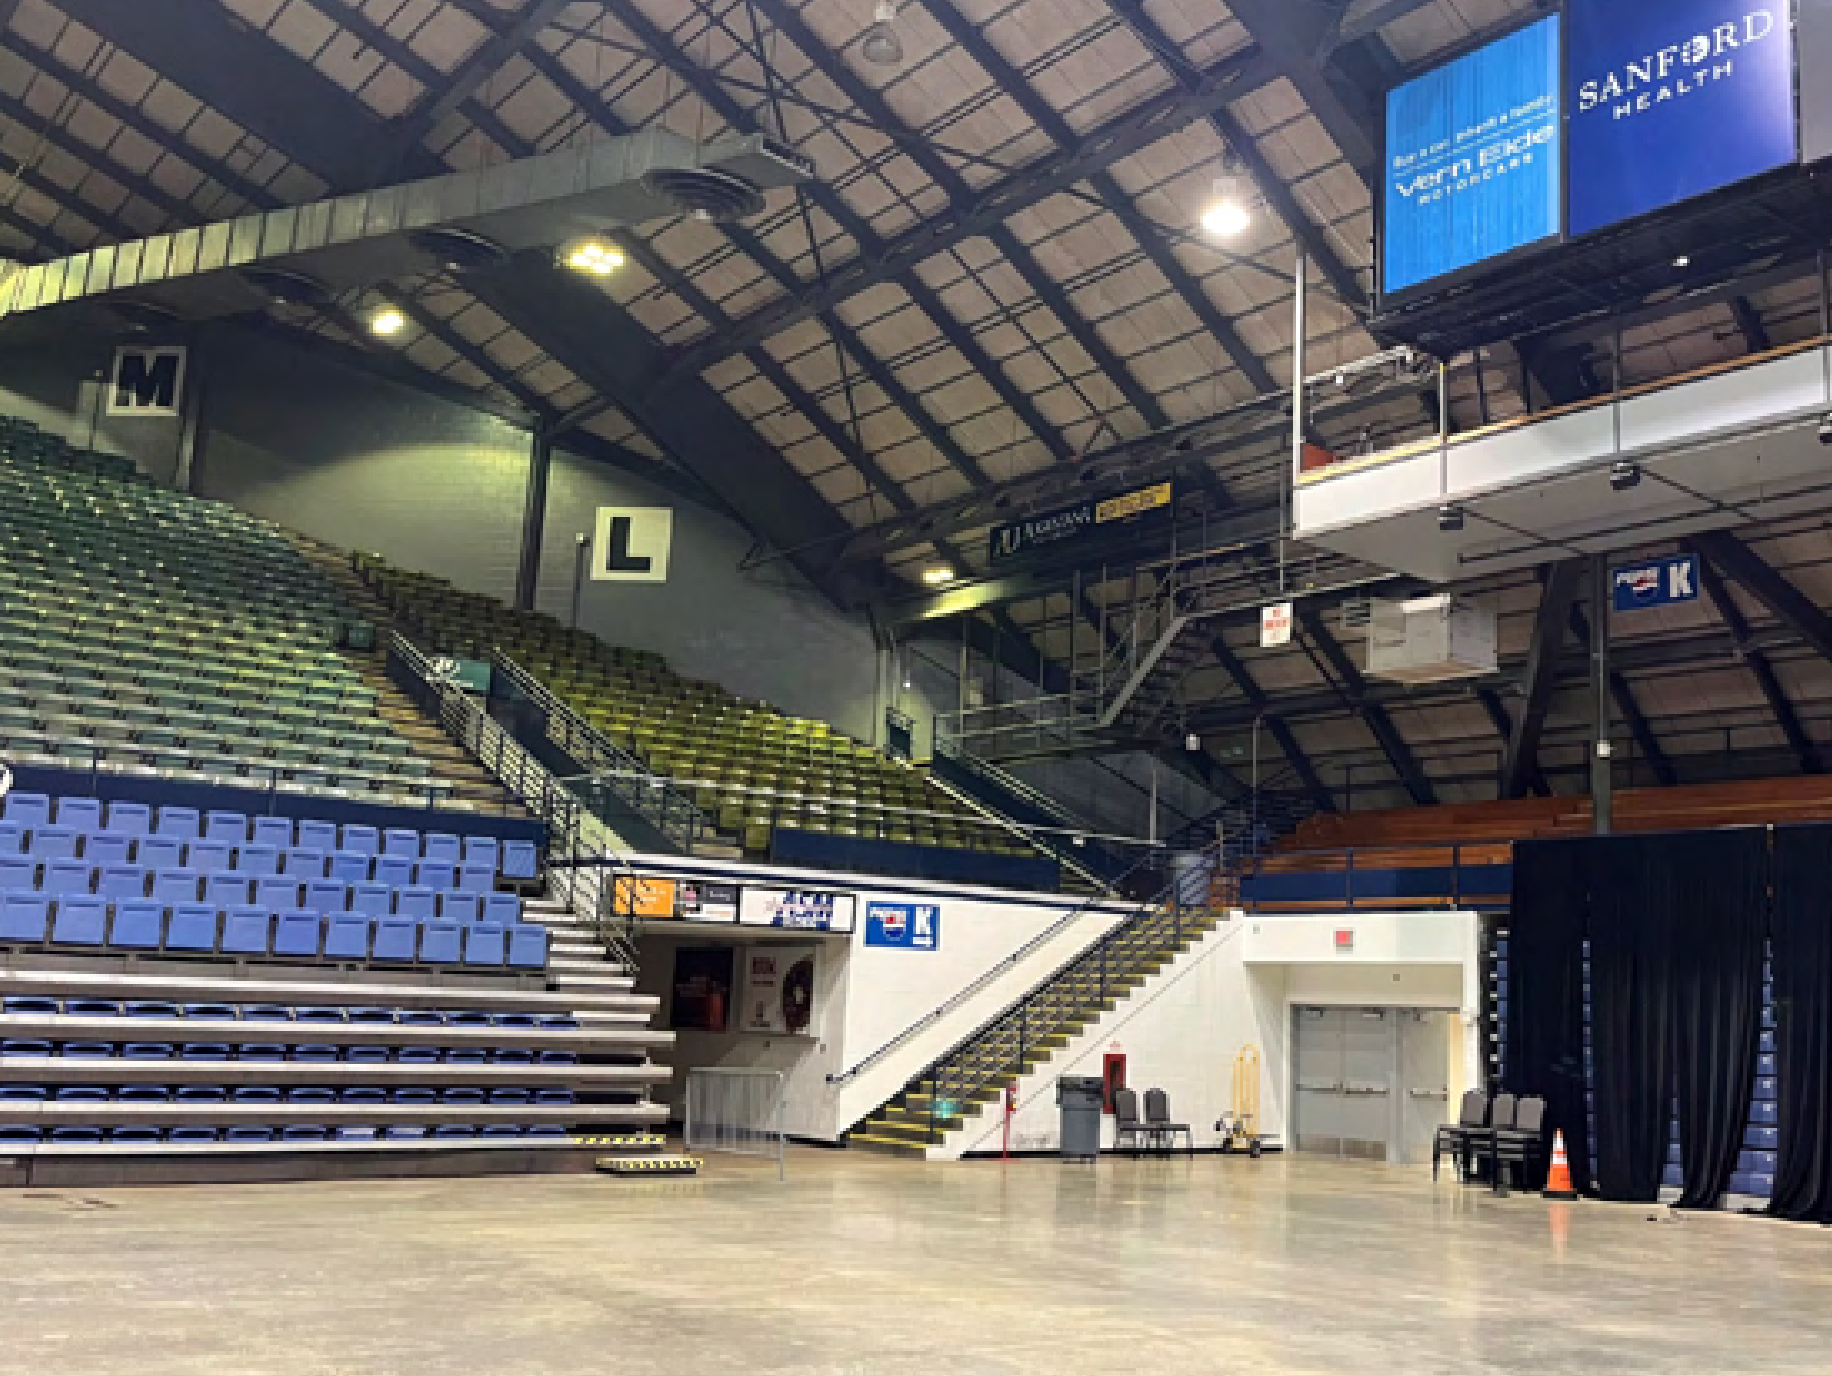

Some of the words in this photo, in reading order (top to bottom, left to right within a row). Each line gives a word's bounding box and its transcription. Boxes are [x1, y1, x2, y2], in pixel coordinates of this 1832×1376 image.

[1579, 8, 1774, 113] SANFORD
[1612, 58, 1734, 120] HEALTH
[116, 352, 179, 407] M
[606, 516, 651, 572] L
[1668, 560, 1693, 597] K
[914, 904, 936, 935] K
